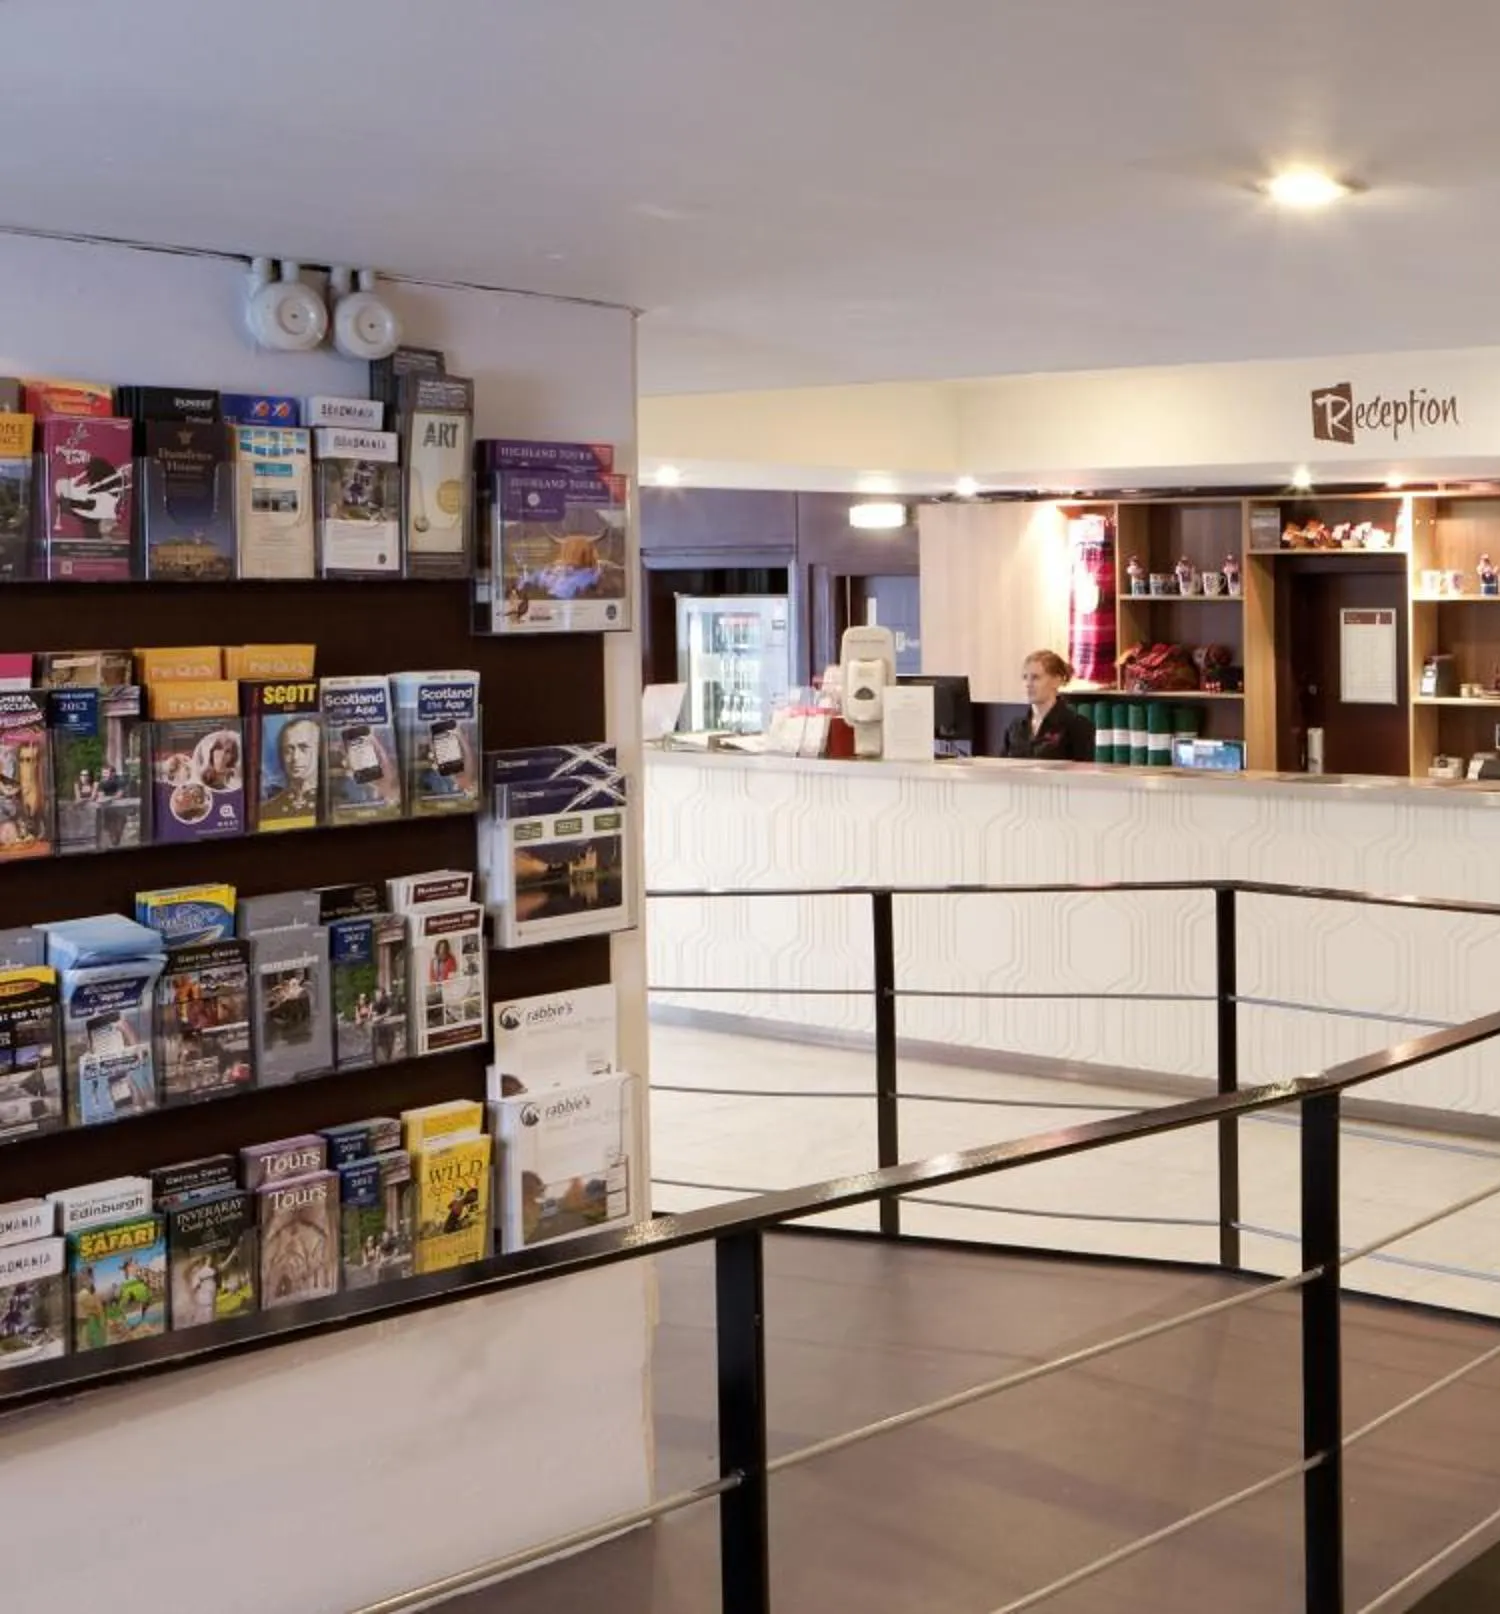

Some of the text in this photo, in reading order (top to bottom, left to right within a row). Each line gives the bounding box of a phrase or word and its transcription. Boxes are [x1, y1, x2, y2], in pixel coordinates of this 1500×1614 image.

[1312, 384, 1458, 443] Reception
[422, 420, 459, 449] ART
[263, 684, 317, 705] SCOTT
[324, 690, 384, 706] Scotland
[421, 687, 473, 700] Scotland
[525, 1001, 574, 1022] rabbie's
[545, 1095, 592, 1118] rabbie's
[260, 1151, 321, 1175] Tours
[429, 1159, 483, 1185] WILD
[69, 1195, 144, 1222] Edinburgh
[269, 1184, 327, 1210] Tours
[80, 1226, 155, 1258] SAFARI
